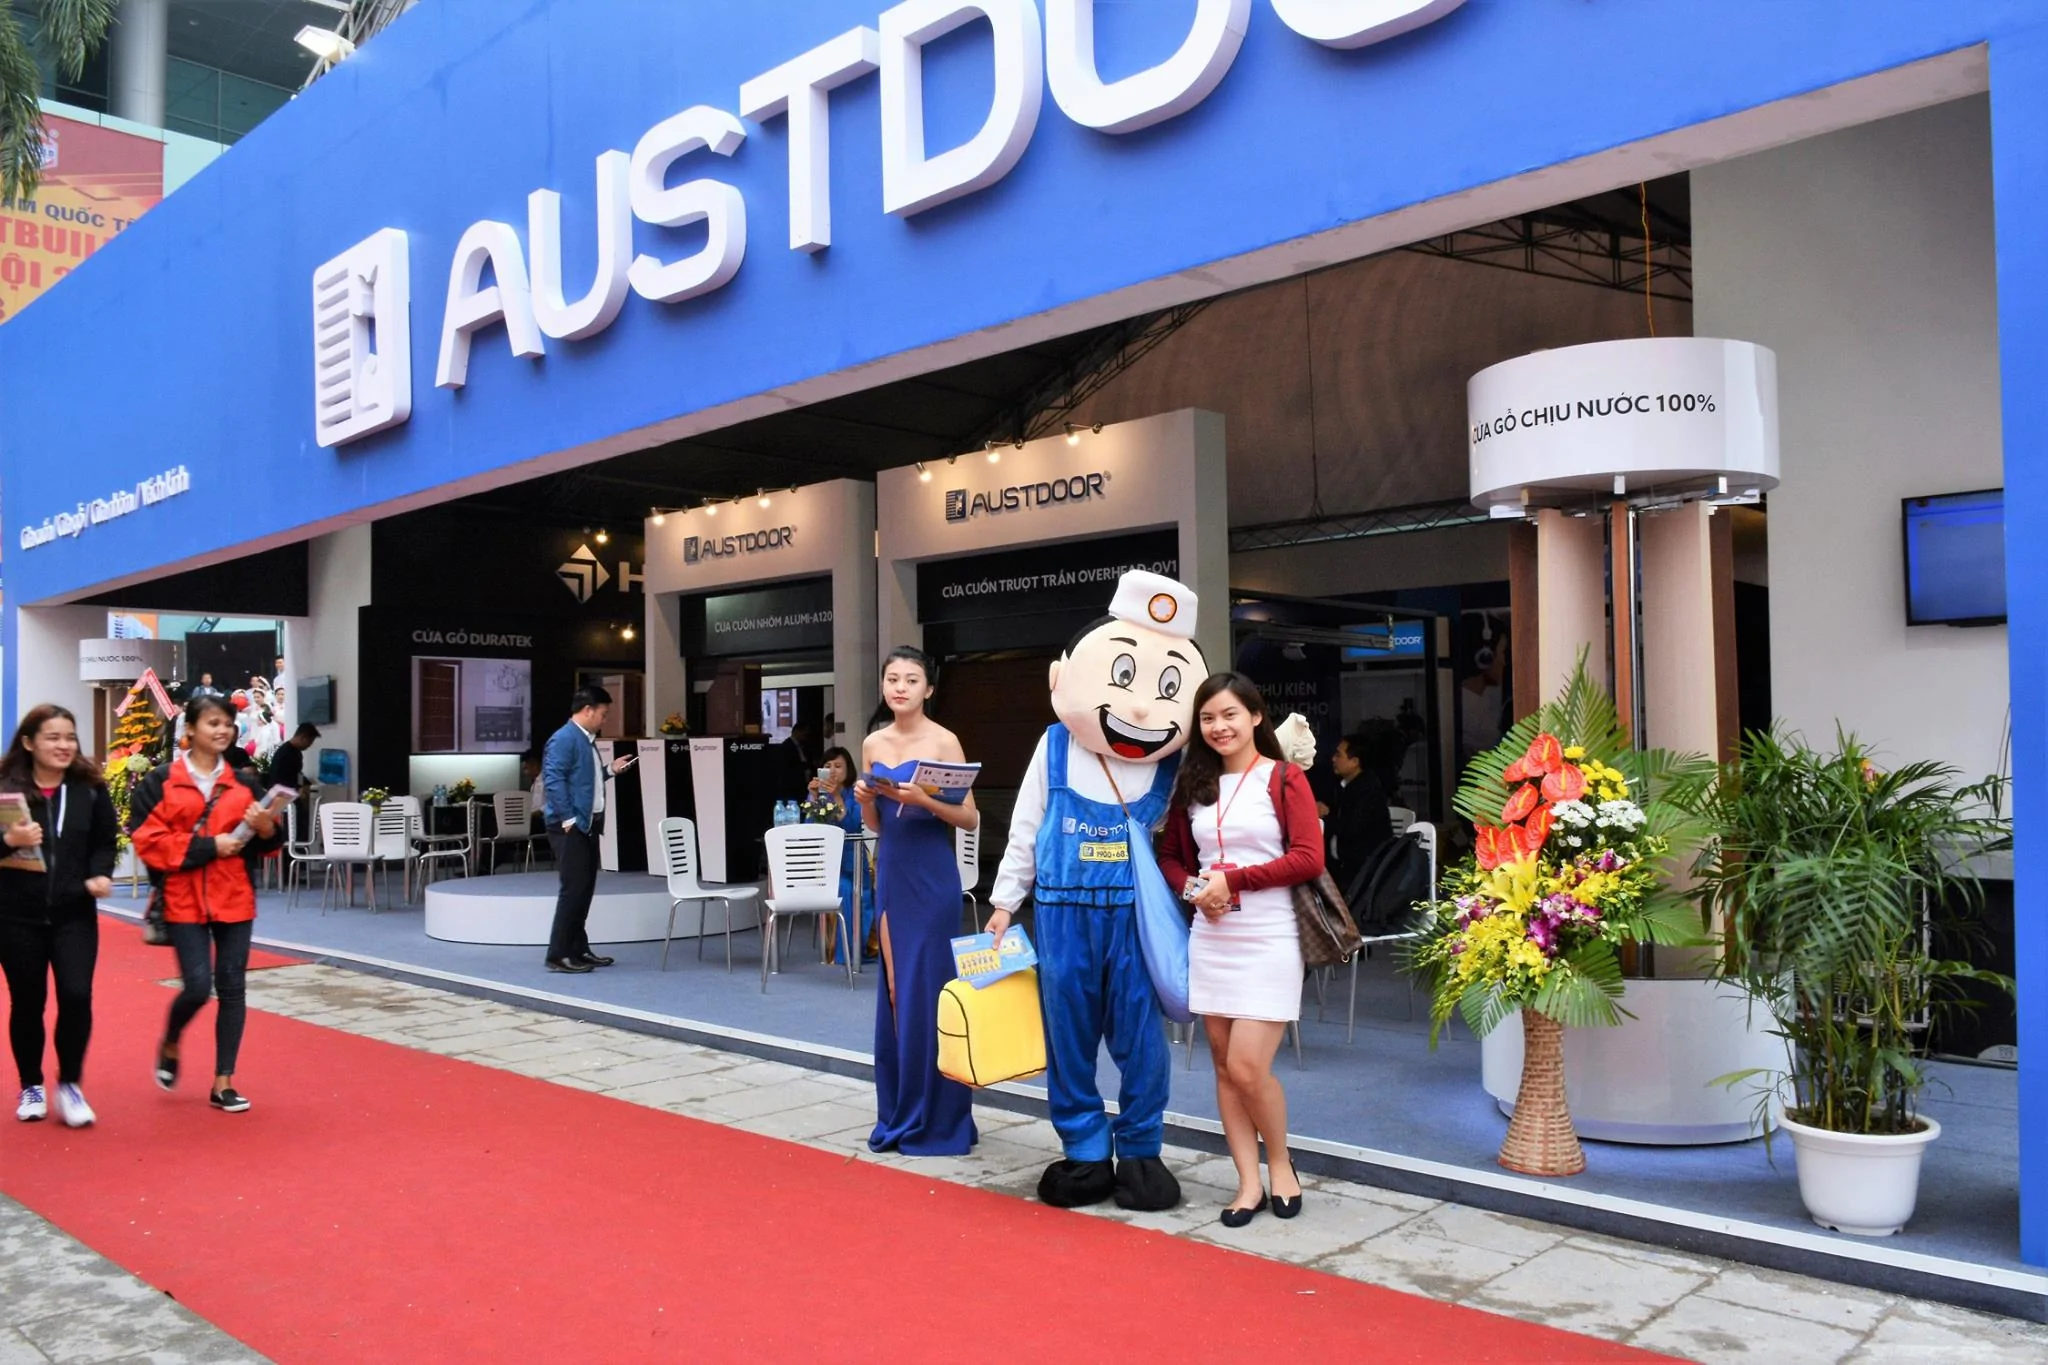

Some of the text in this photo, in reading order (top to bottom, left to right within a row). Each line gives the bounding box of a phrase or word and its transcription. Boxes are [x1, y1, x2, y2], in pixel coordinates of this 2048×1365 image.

[44, 203, 105, 228] QUỐC
[1493, 408, 1517, 435] GỖ
[1521, 402, 1570, 427] CHỊU
[1576, 391, 1650, 419] NƯỚC
[1656, 393, 1716, 413] 100%
[970, 471, 1105, 516] AUSTDOOR
[700, 526, 793, 559] AUSTDOOR
[469, 633, 533, 648] DURATEK
